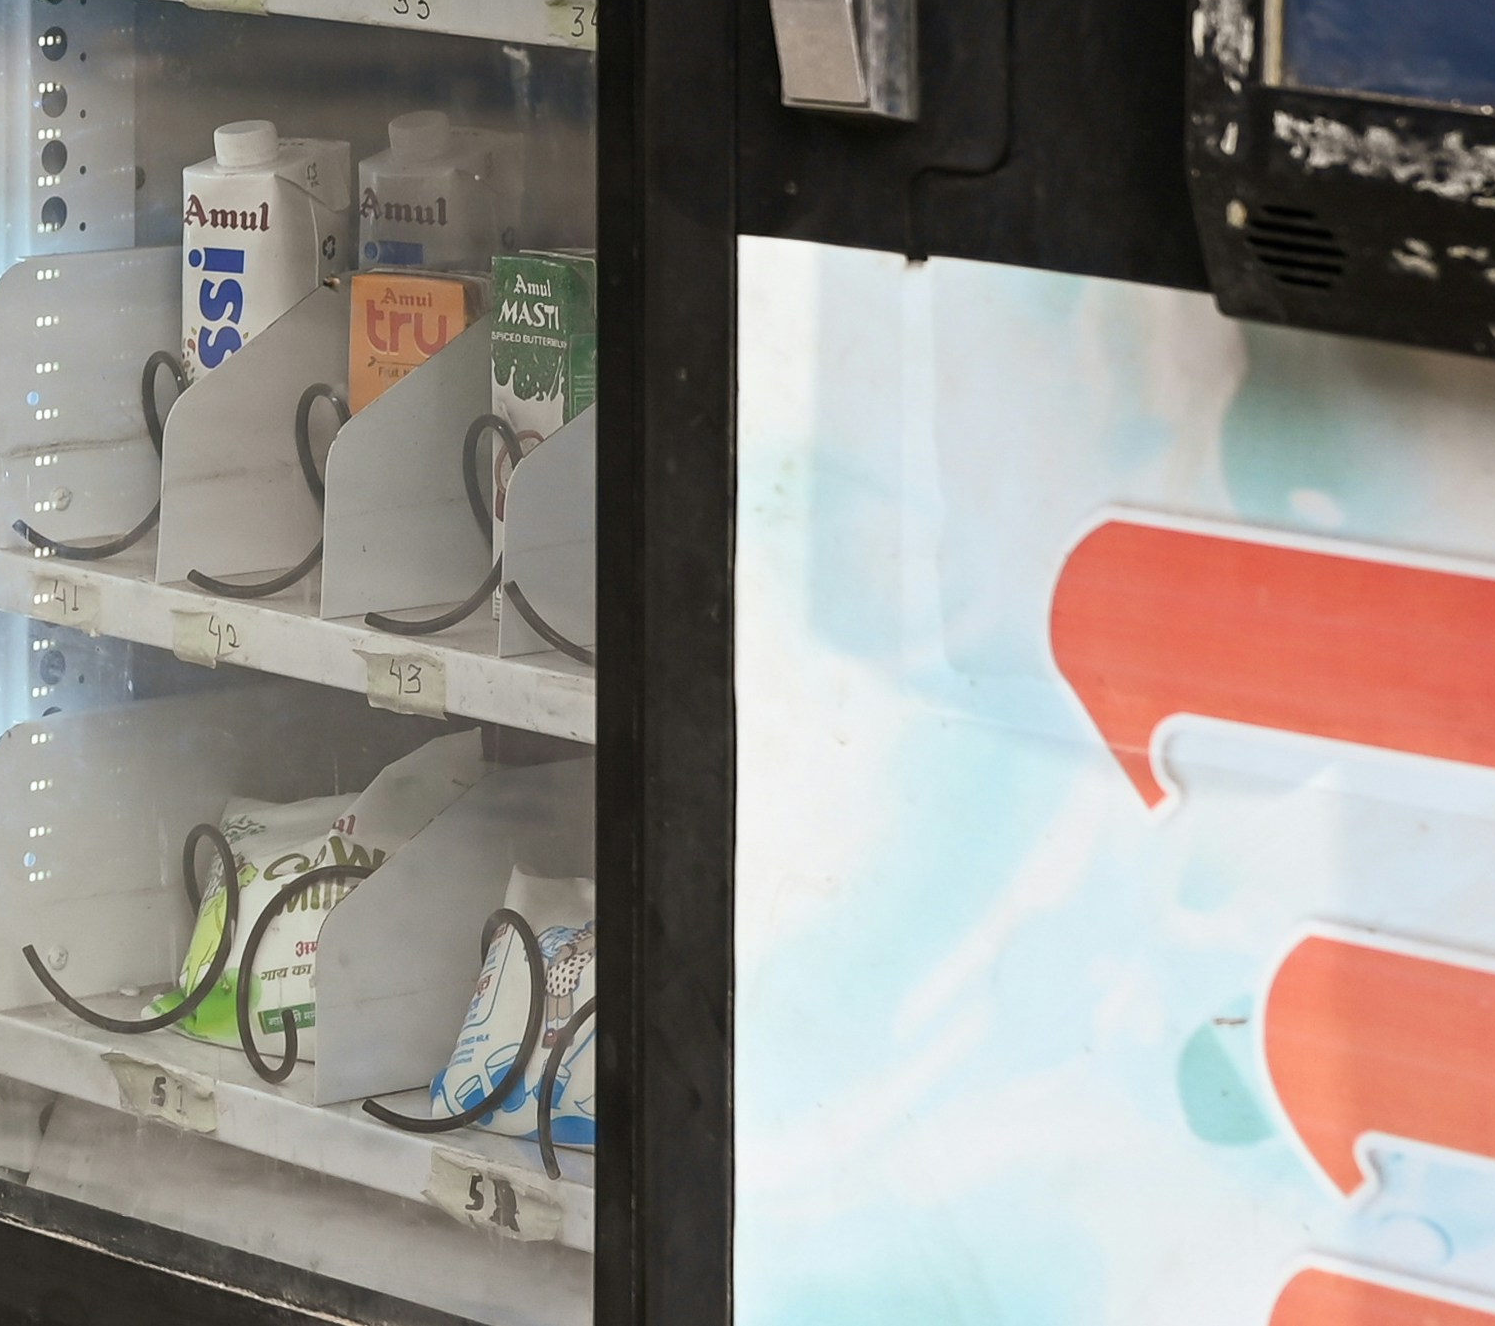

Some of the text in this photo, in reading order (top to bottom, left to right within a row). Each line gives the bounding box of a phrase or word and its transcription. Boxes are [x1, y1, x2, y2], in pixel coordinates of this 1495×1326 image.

[184, 194, 270, 232] Amul
[360, 187, 448, 227] Amul
[381, 287, 433, 308] Amul
[513, 273, 552, 298] Amul
[365, 299, 448, 355] tru
[497, 298, 560, 331] MASTI
[53, 579, 79, 612] 41
[208, 614, 241, 652] 42
[388, 657, 424, 696] 43
[261, 963, 312, 981] गाय का
